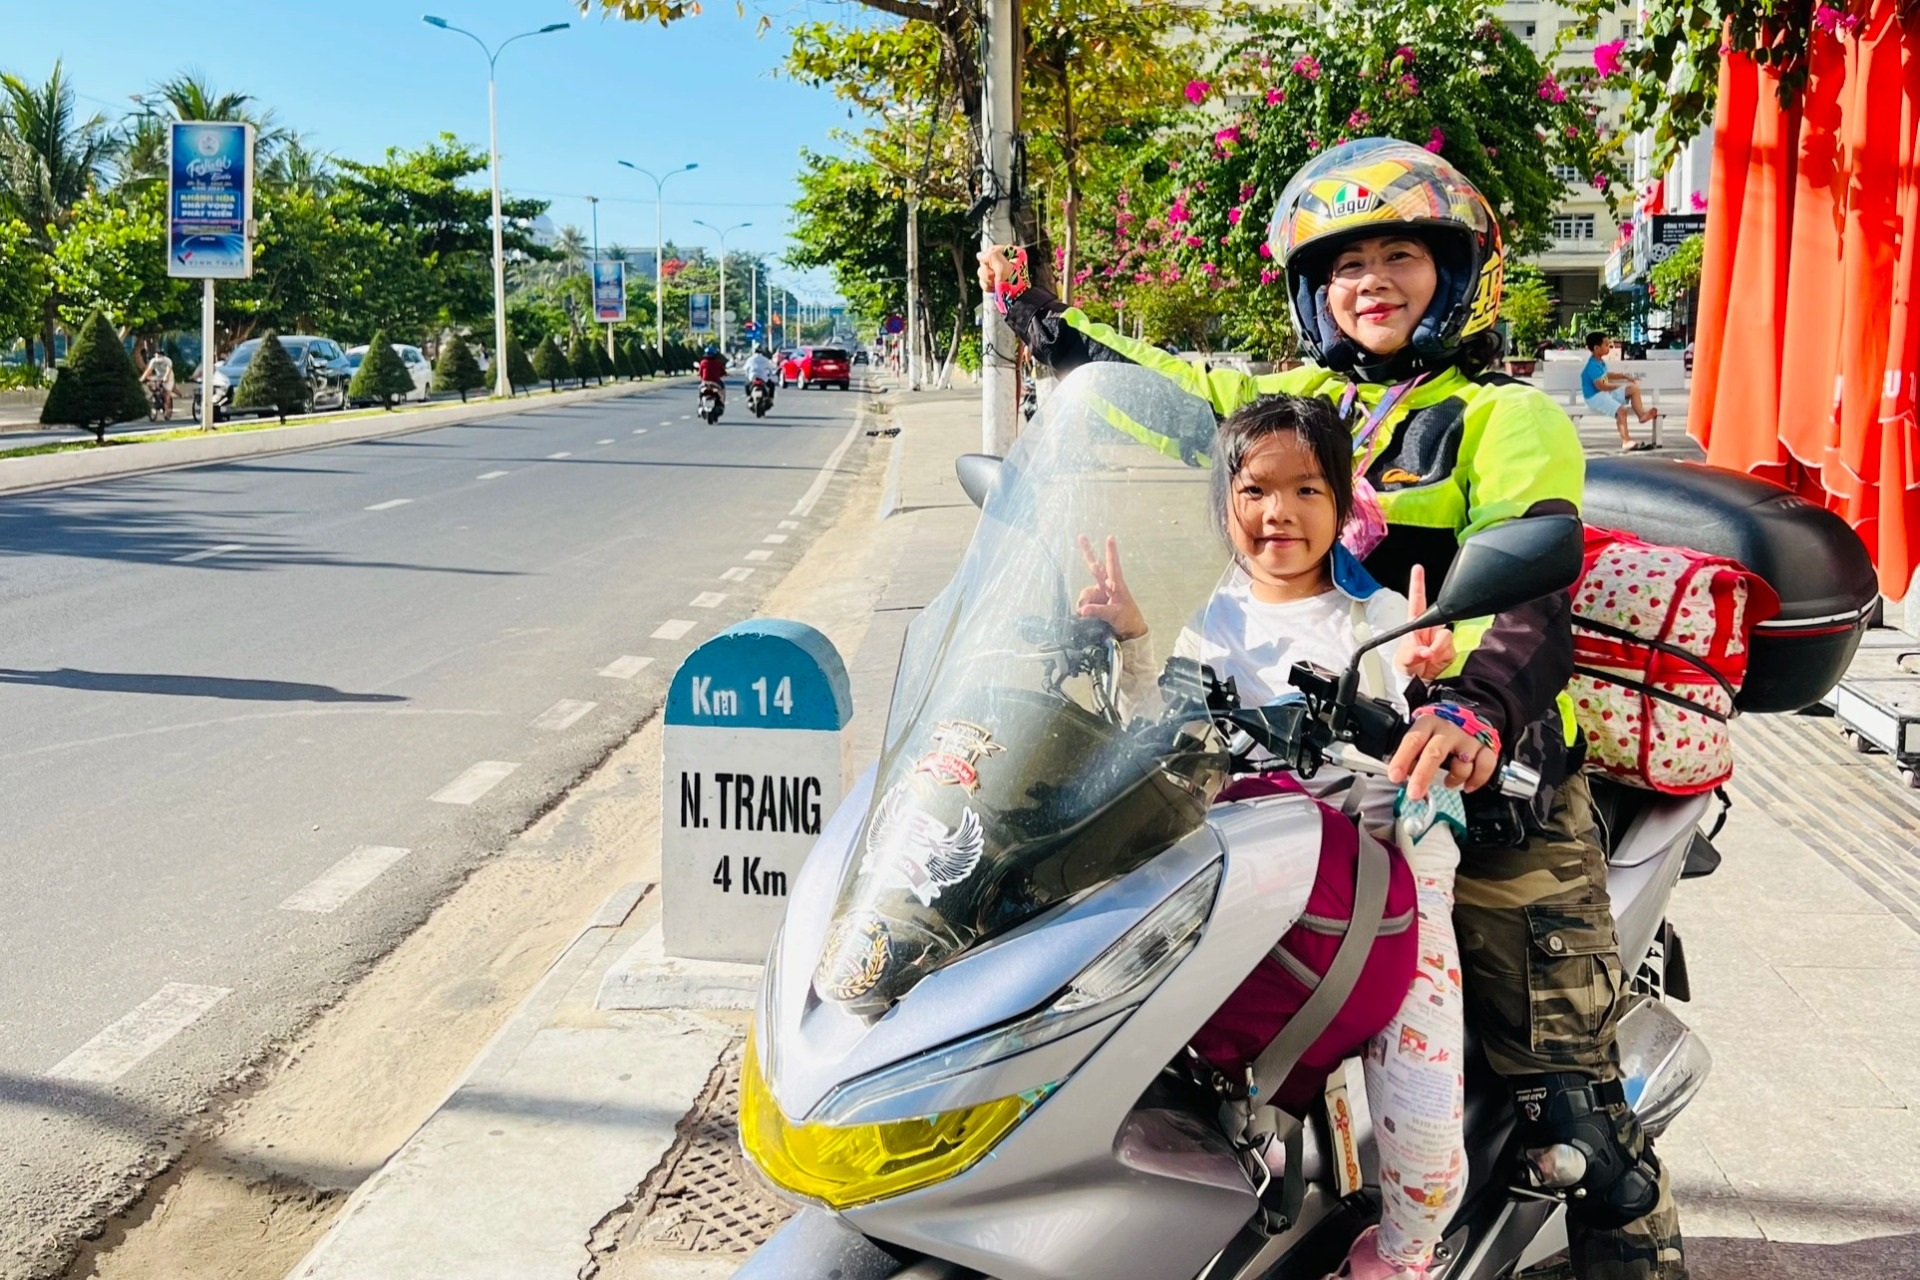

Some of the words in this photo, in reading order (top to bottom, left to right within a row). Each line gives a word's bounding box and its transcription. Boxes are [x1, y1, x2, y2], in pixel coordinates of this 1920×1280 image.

[186, 155, 232, 179] Festival
[692, 676, 738, 716] Km
[751, 676, 793, 716] 14
[713, 855, 732, 893] 4
[742, 856, 787, 897] Km
